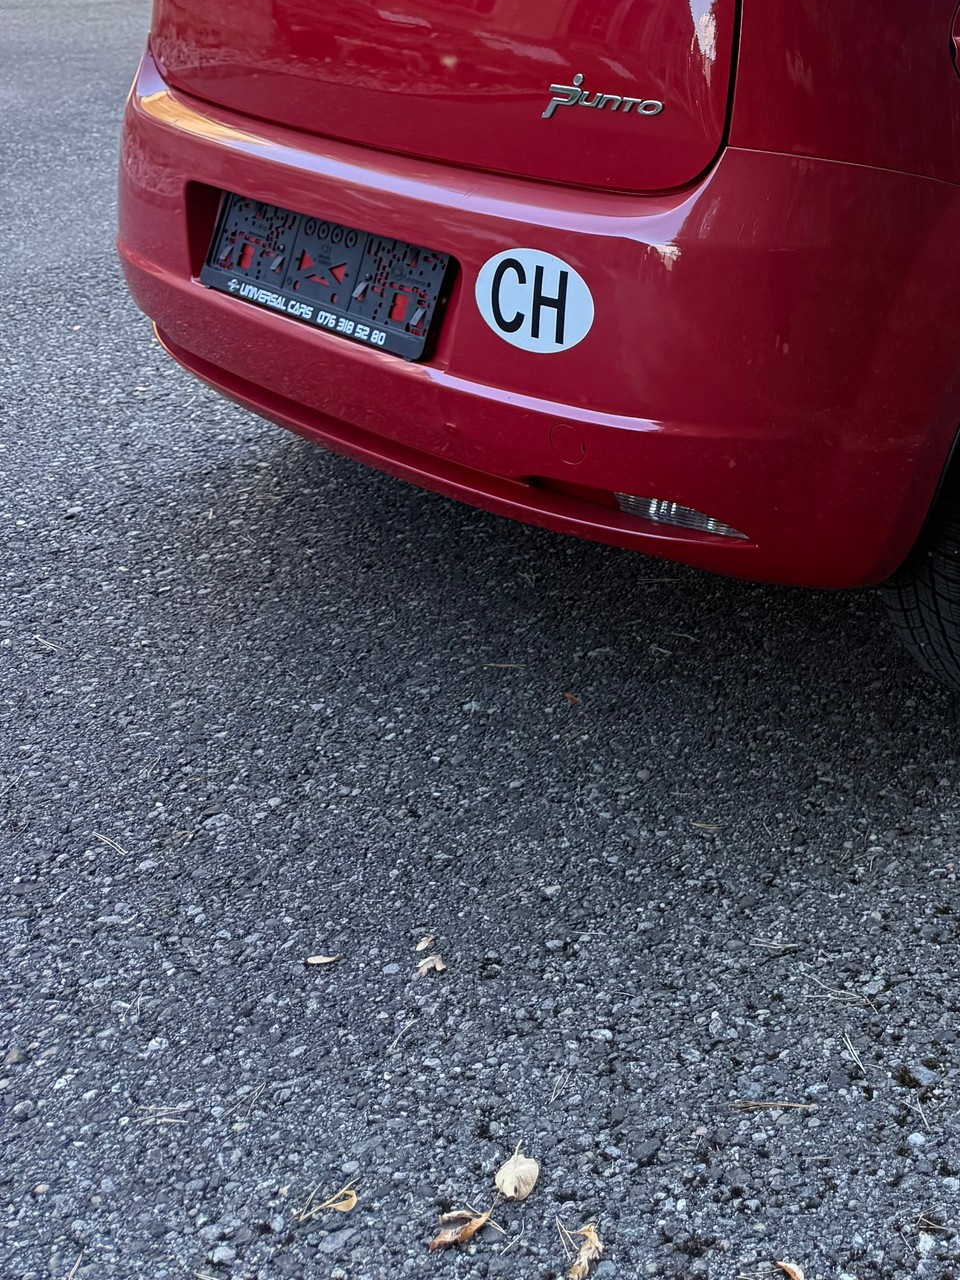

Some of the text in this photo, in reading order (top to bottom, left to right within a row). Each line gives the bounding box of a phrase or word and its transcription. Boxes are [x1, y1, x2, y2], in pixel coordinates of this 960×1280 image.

[239, 282, 387, 346] UNIVERSAL CARS 076 318 52 80
[491, 258, 569, 345] CH
